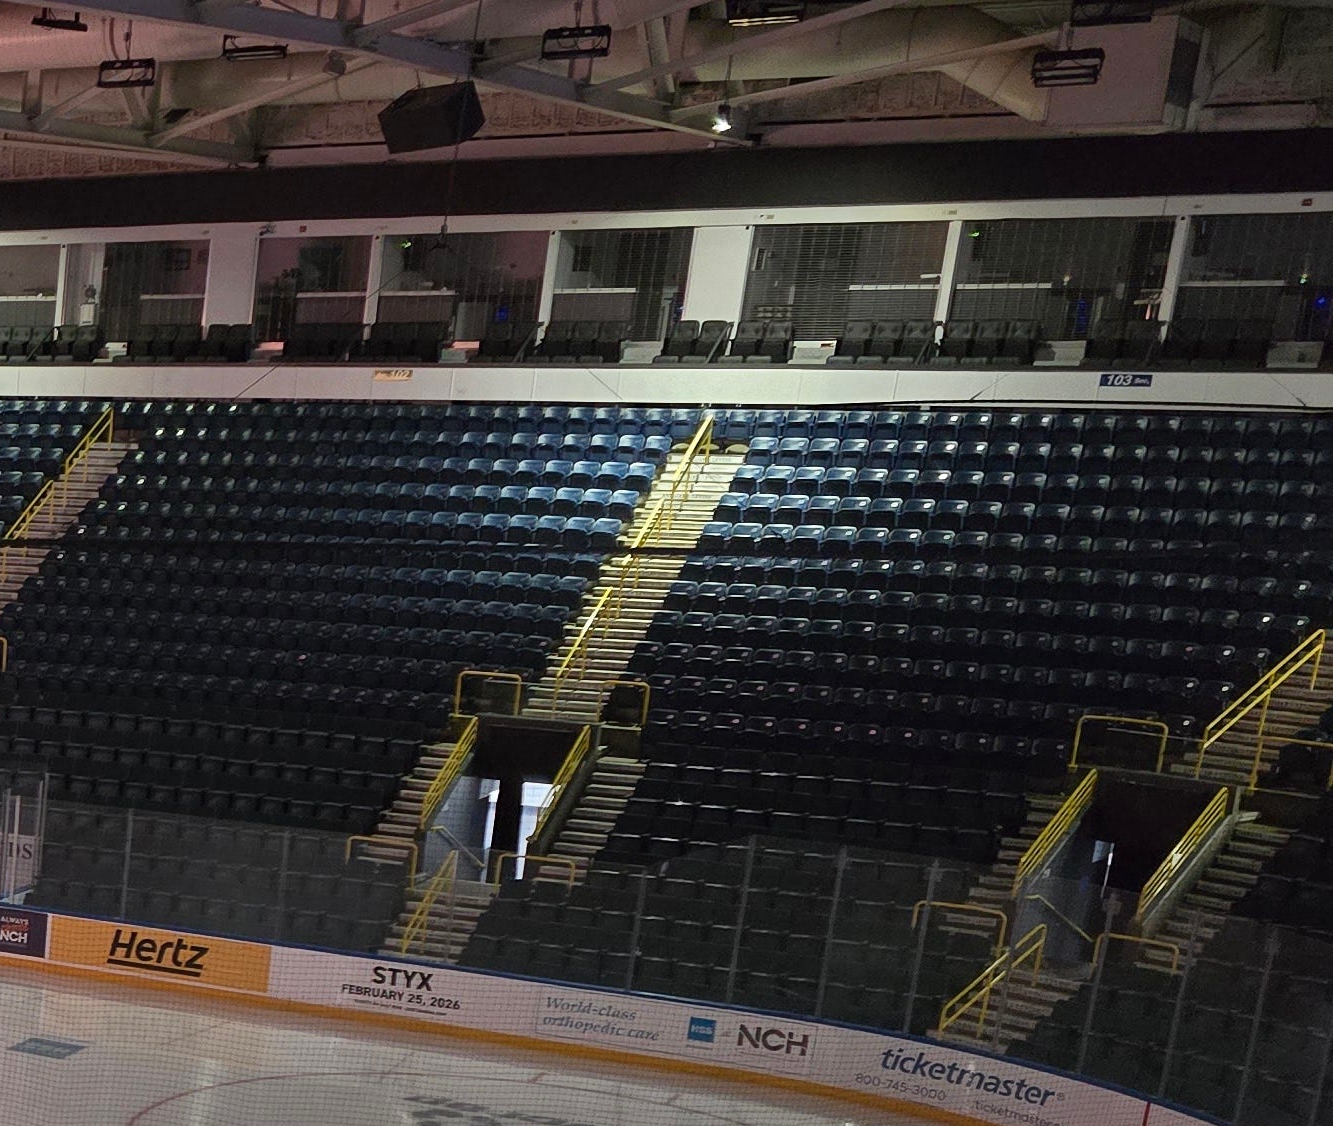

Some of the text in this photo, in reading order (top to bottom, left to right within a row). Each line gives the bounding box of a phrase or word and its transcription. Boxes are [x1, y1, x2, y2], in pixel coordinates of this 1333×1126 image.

[1107, 374, 1133, 385] 103
[0, 929, 28, 944] NCH
[109, 929, 210, 971] Hertz
[371, 965, 434, 992] STYX
[341, 982, 406, 1003] FEBRUARY
[407, 993, 426, 1007] 25,
[430, 996, 461, 1010] 2026
[546, 996, 637, 1021] World-class
[542, 1016, 660, 1042] orthopedic care
[737, 1023, 809, 1056] NCH
[854, 1072, 946, 1101] 800-745-3000
[881, 1047, 1055, 1107] ticketmaster
